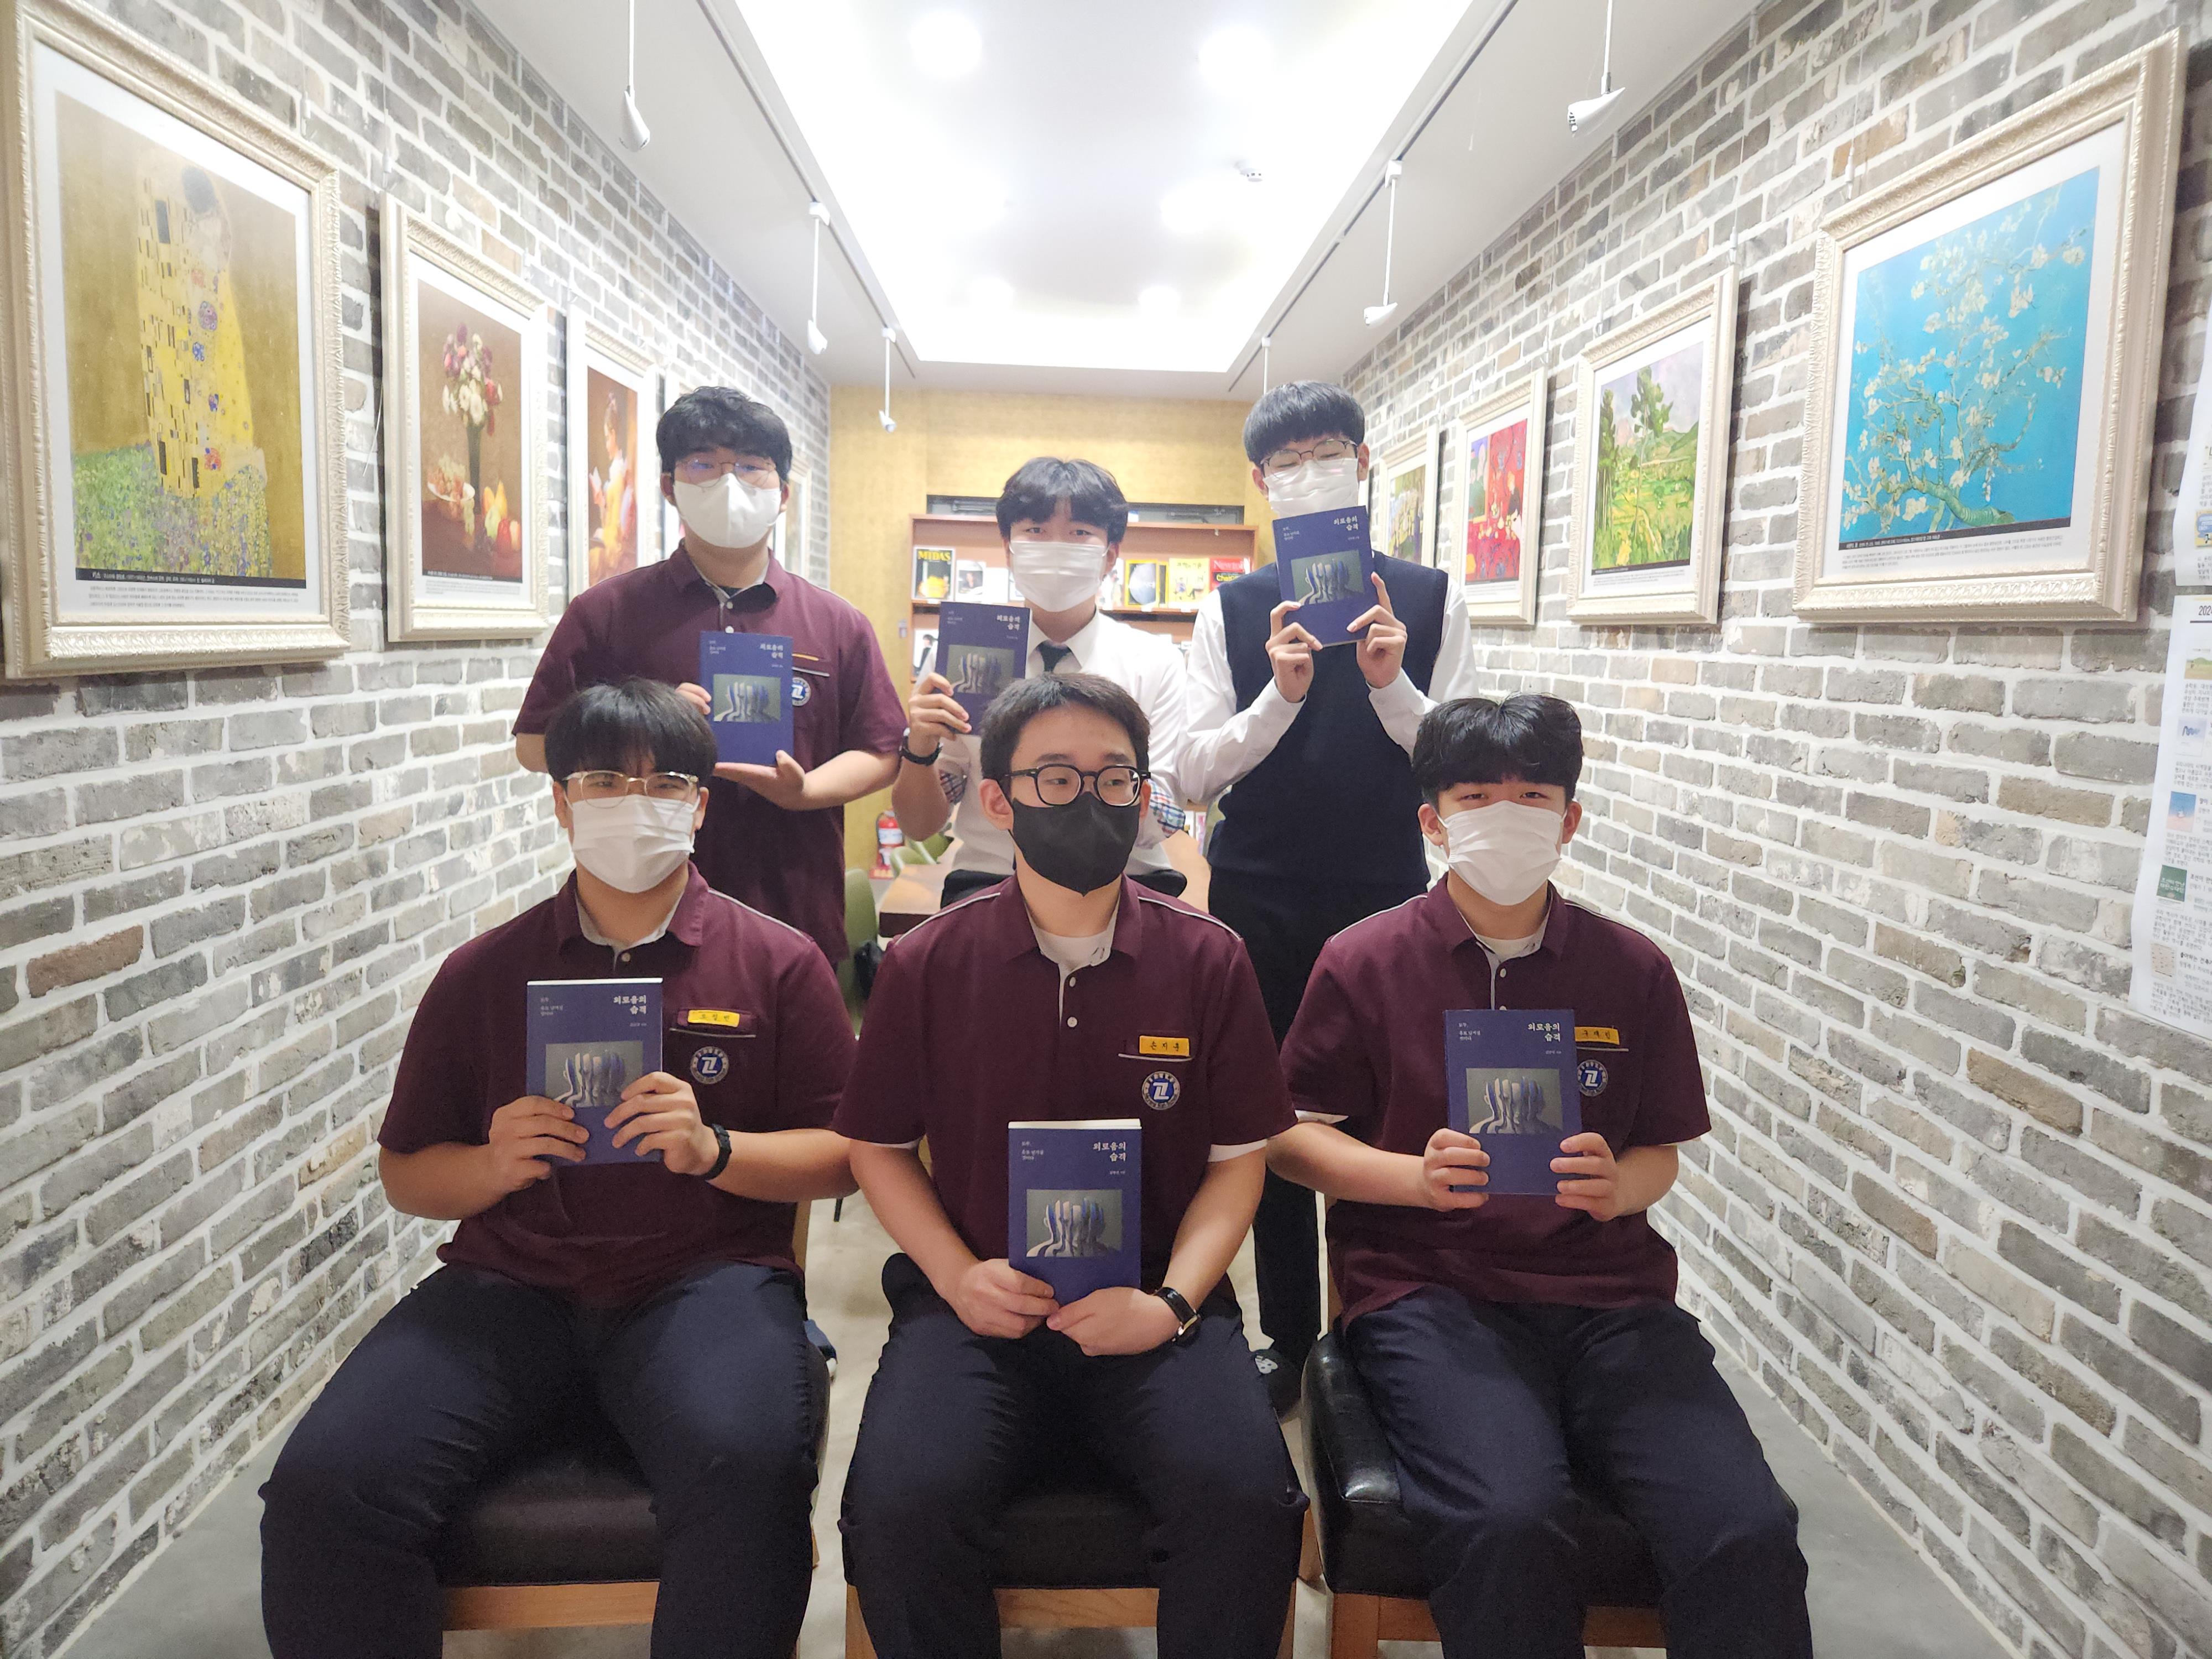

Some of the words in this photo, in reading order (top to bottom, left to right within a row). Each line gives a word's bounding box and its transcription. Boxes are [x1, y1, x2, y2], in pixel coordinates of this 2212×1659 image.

[918, 550, 951, 561] MIDAS
[2199, 606, 2212, 615] 202
[613, 994, 646, 1005] 외로움의
[629, 1005, 646, 1015] 습격
[1527, 1022, 1560, 1031] 외로움의
[1544, 1032, 1561, 1042] 습격
[1093, 1141, 1126, 1151] 외로움의
[1109, 1152, 1126, 1161] 습격
